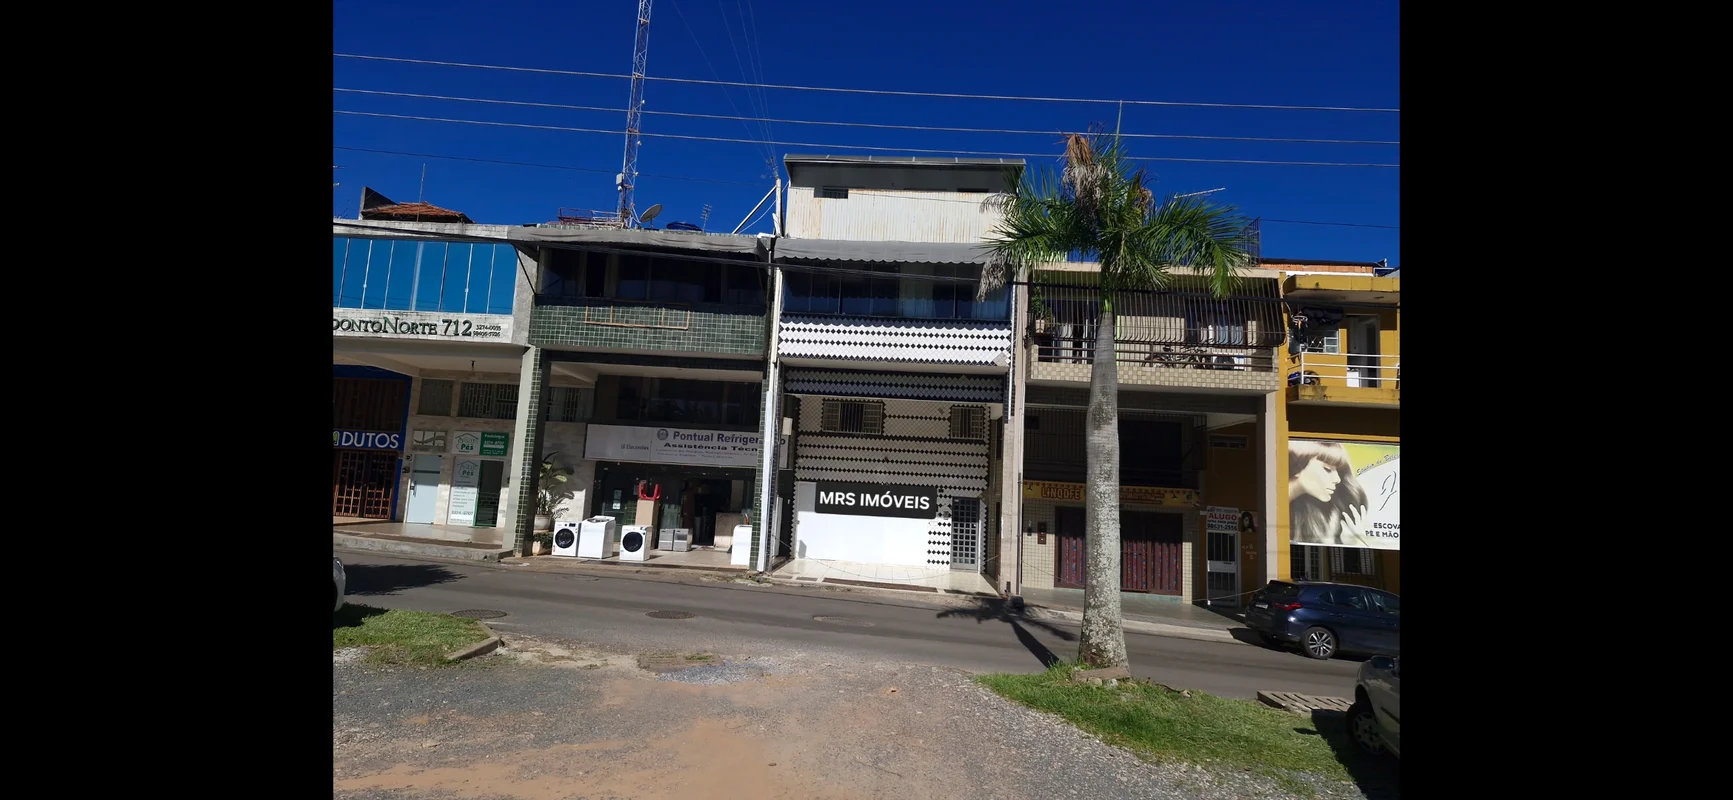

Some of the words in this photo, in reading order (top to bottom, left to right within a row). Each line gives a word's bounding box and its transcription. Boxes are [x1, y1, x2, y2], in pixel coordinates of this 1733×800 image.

[442, 318, 472, 337] 712
[341, 431, 399, 449] DUTOS
[673, 430, 714, 443] Pontual
[663, 442, 728, 451] Assistência
[1208, 513, 1237, 521] ALUGO
[1382, 530, 1399, 538] MÃO
